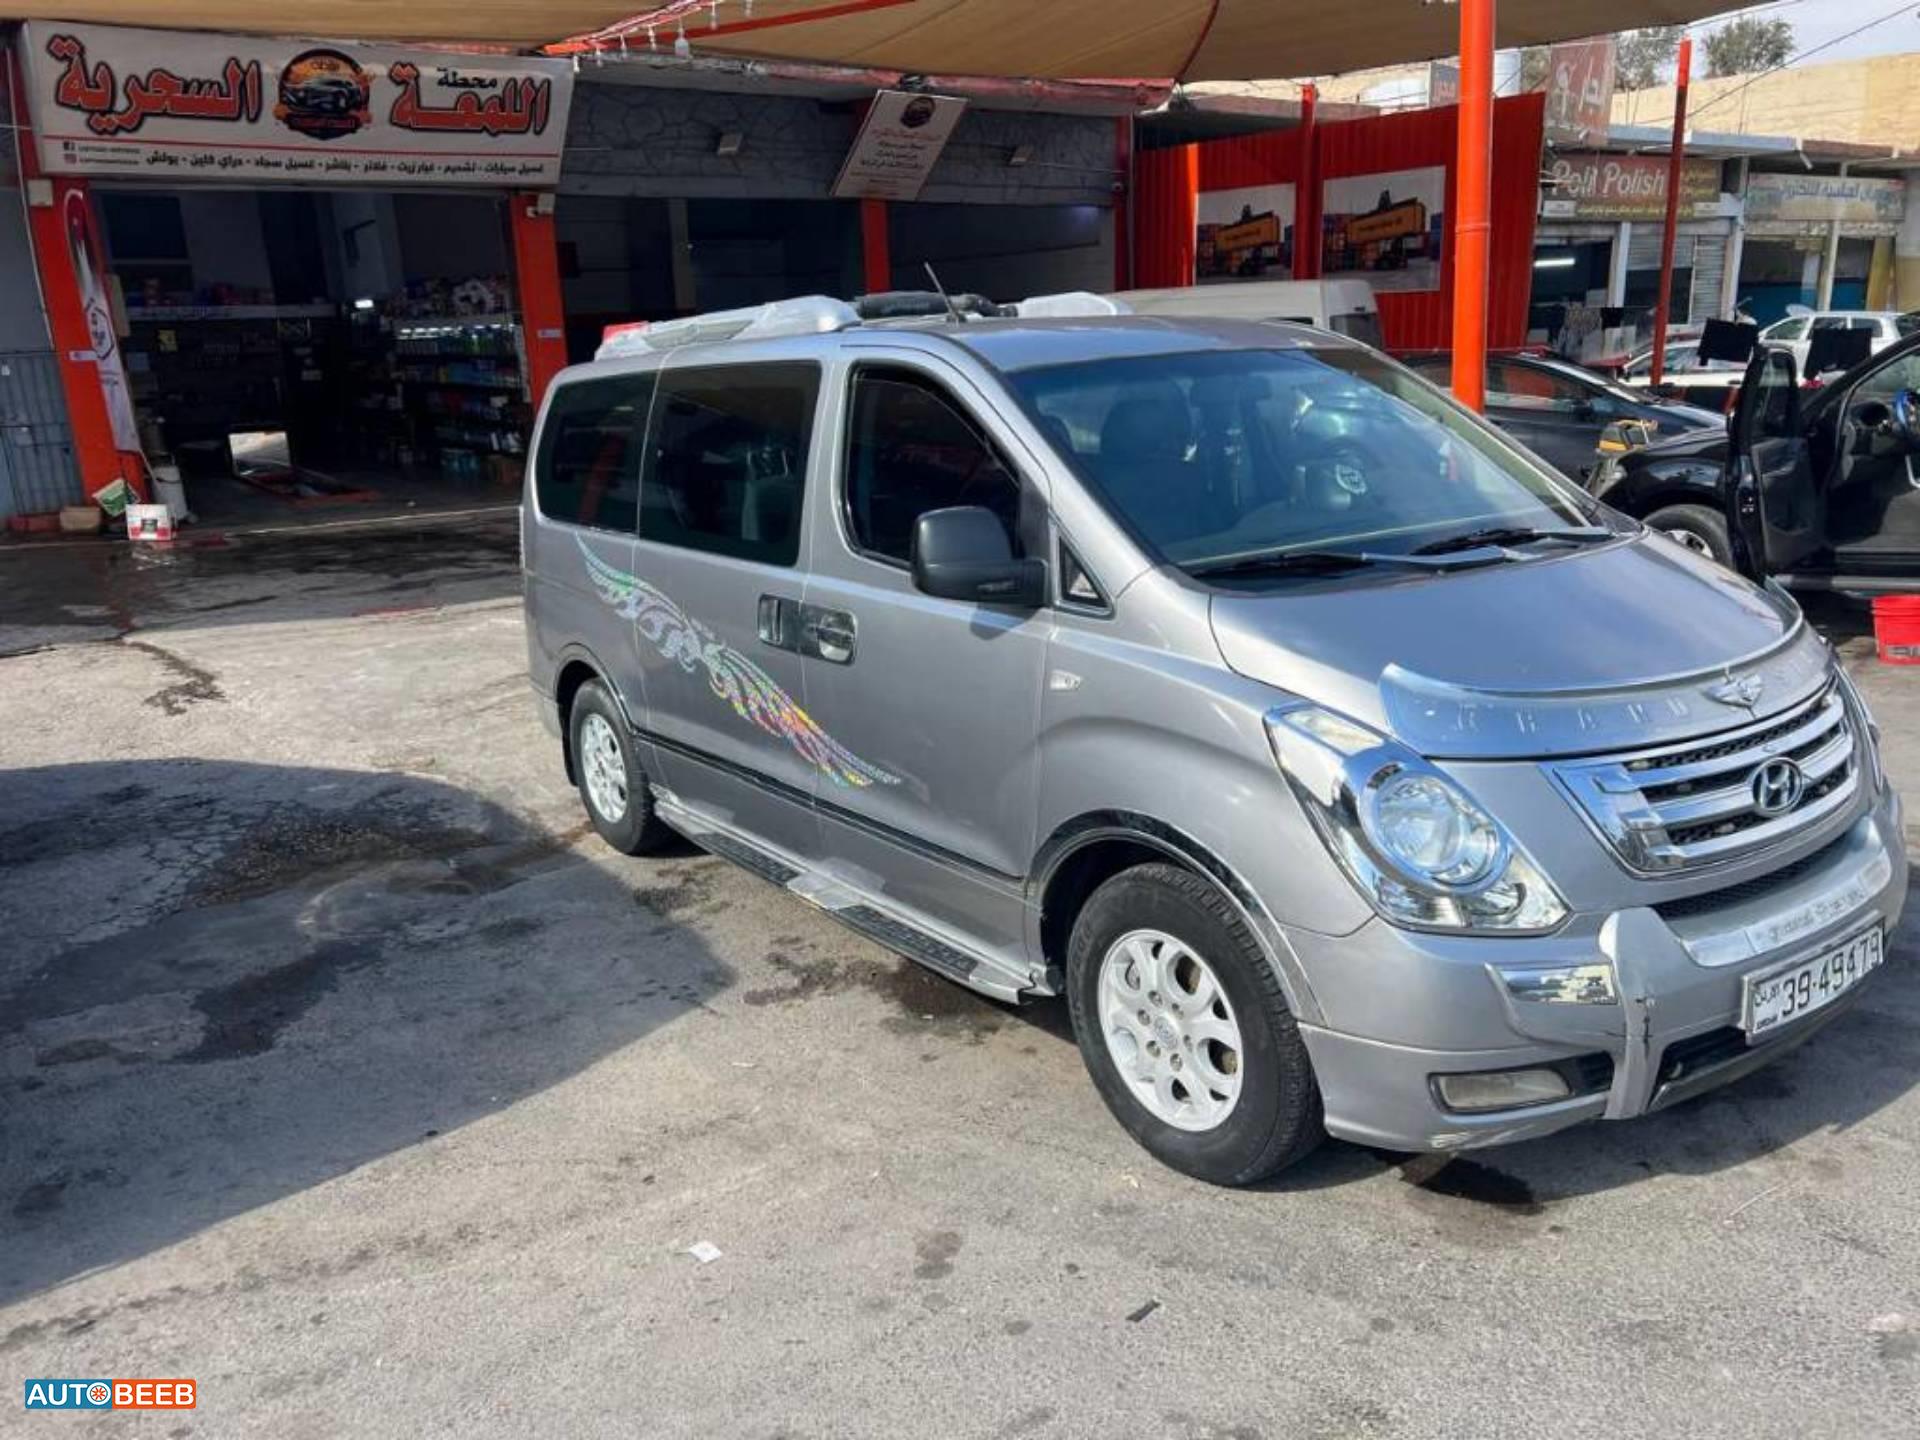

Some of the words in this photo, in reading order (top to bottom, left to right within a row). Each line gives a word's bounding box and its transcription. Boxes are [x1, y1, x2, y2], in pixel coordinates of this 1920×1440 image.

[47, 34, 263, 134] السحرية
[436, 66, 498, 89] محطة
[389, 61, 551, 136] اللمعة
[255, 155, 282, 168] سجاد
[285, 157, 315, 171] غسيل
[485, 160, 516, 174] سيارات
[1602, 161, 1666, 198] Polish
